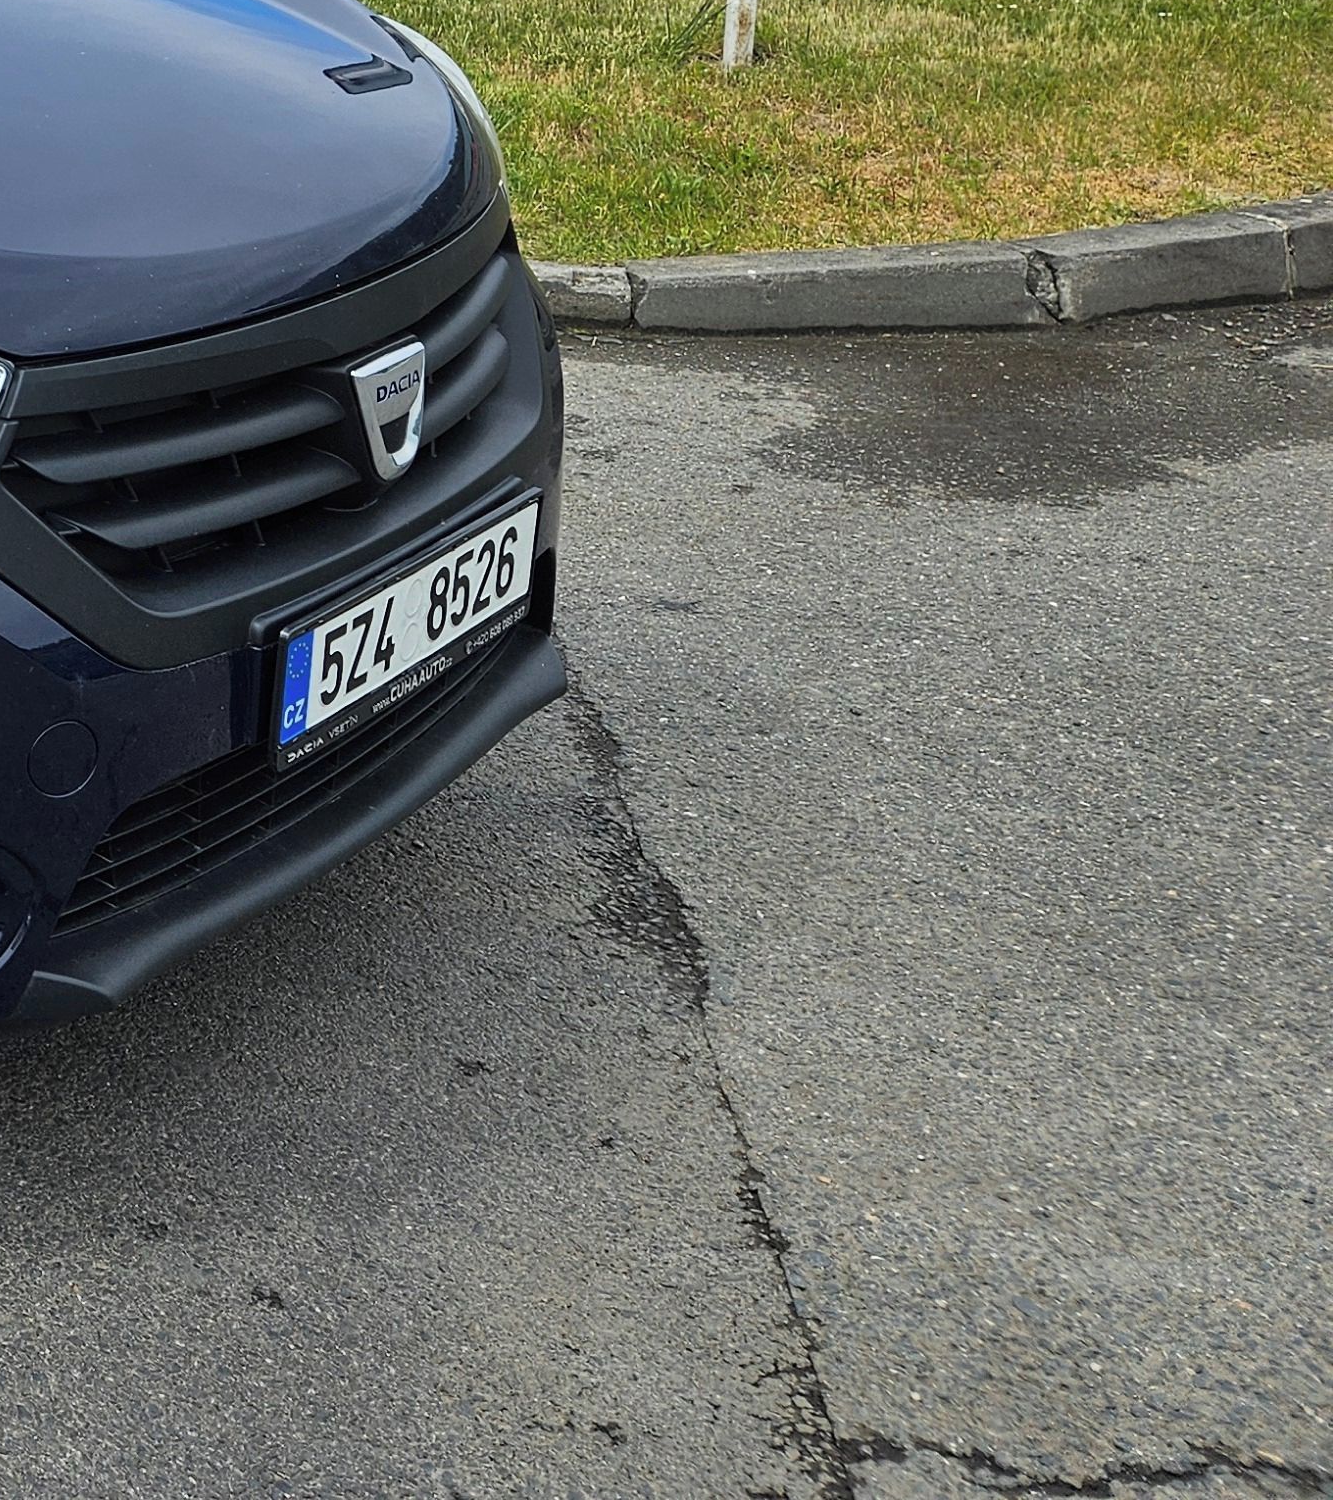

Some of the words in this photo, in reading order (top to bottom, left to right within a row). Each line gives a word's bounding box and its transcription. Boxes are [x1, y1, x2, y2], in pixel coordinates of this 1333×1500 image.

[376, 370, 421, 403] DACIA
[283, 698, 306, 729] CZ
[319, 595, 396, 707] 5Z4
[425, 525, 518, 642] 8526
[287, 736, 325, 763] DACIA
